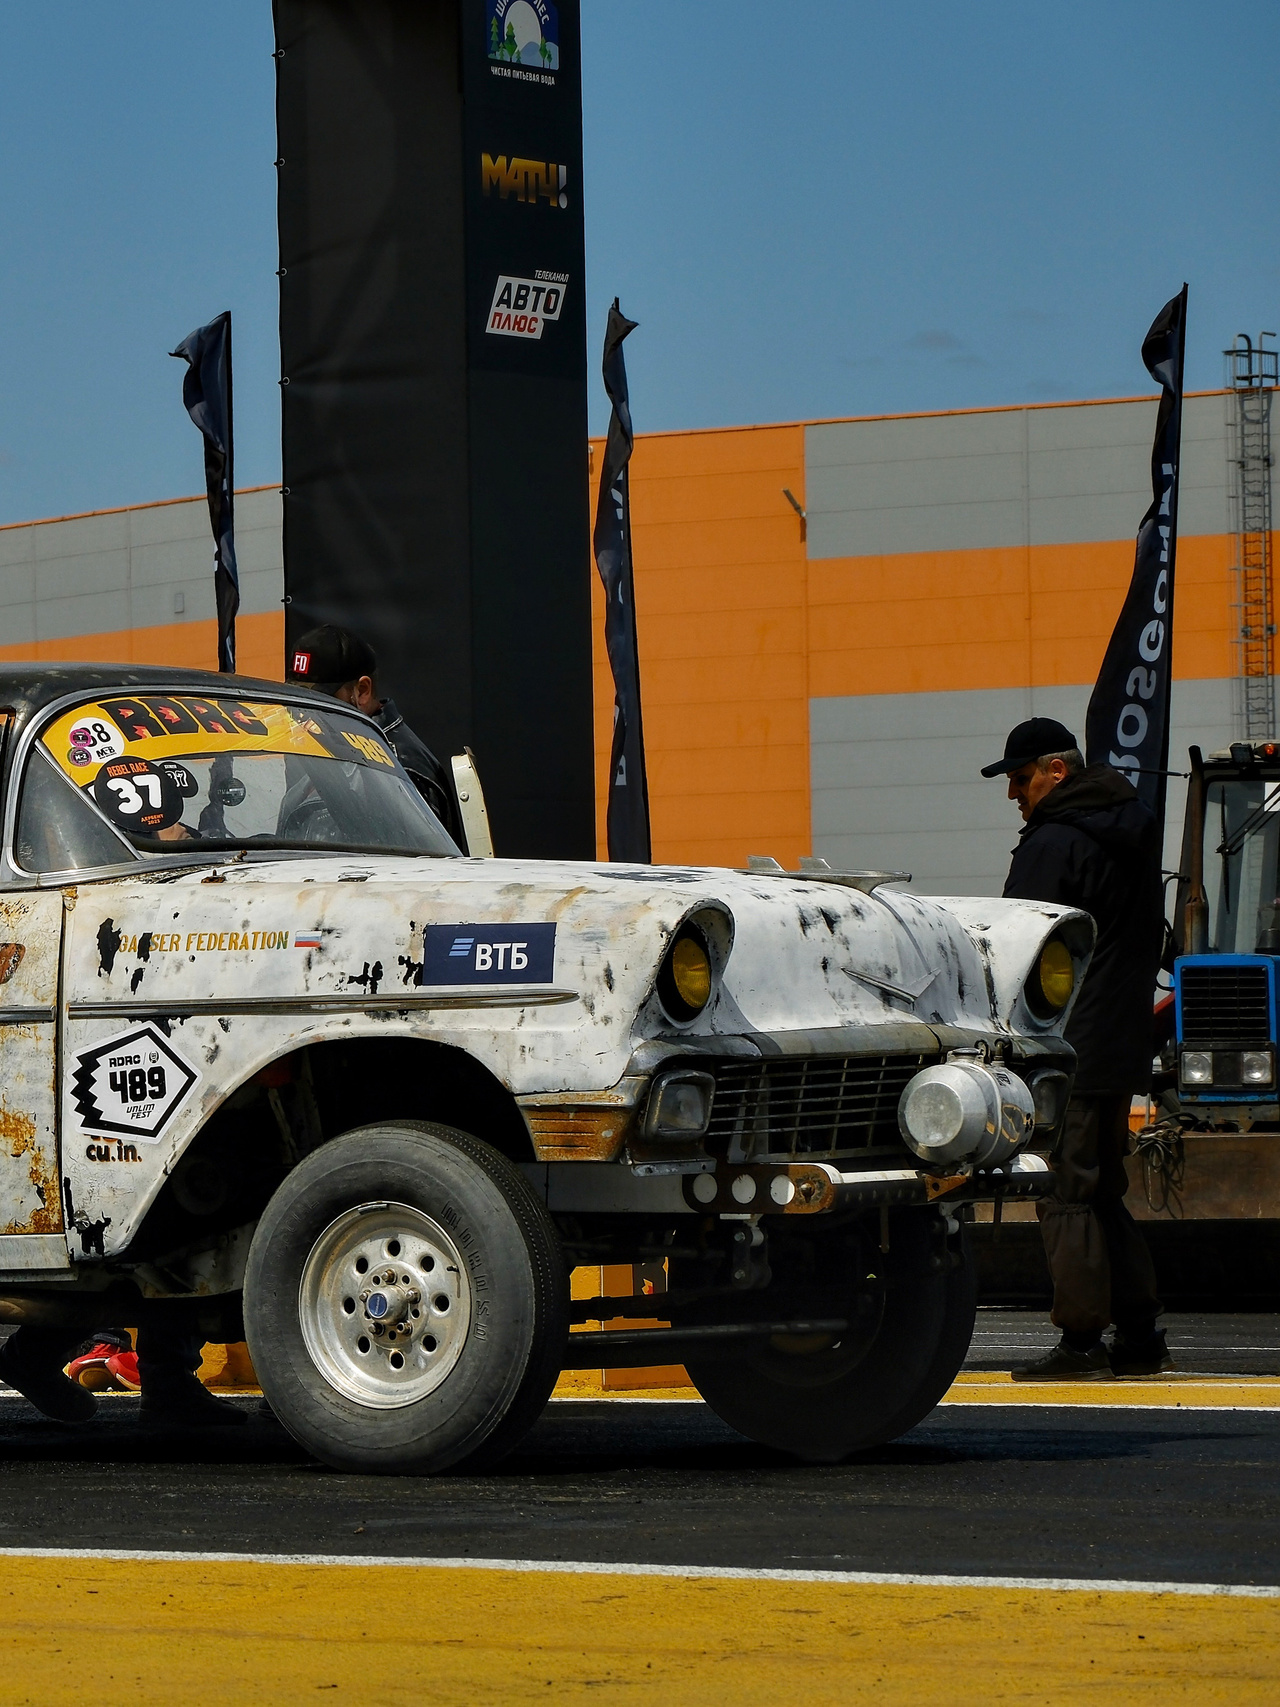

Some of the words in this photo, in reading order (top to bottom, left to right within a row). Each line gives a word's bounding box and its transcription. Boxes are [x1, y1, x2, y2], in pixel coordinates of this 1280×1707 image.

[491, 66, 511, 78] ЧИСТАЯ
[512, 69, 539, 82] ПИТЬЕВАЯ
[540, 75, 555, 86] ВОДА
[534, 269, 569, 283] ТЕЛЕКАНАЛ
[495, 282, 561, 315] АВТО
[490, 313, 539, 334] ПЛЮС
[294, 655, 307, 672] FD
[97, 697, 269, 742] RDRC
[340, 730, 396, 769] 489
[106, 765, 131, 777] REBEL
[130, 762, 150, 773] RACE
[106, 774, 162, 814] 37
[120, 933, 182, 953] GASER
[186, 931, 290, 952] FEDERATION
[474, 941, 529, 971] ВТБ
[109, 1055, 141, 1068] RDRC
[109, 1066, 167, 1104] 489
[126, 1103, 155, 1114] UNLIM
[130, 1110, 152, 1120] FEST
[86, 1139, 143, 1162] cu.in.
